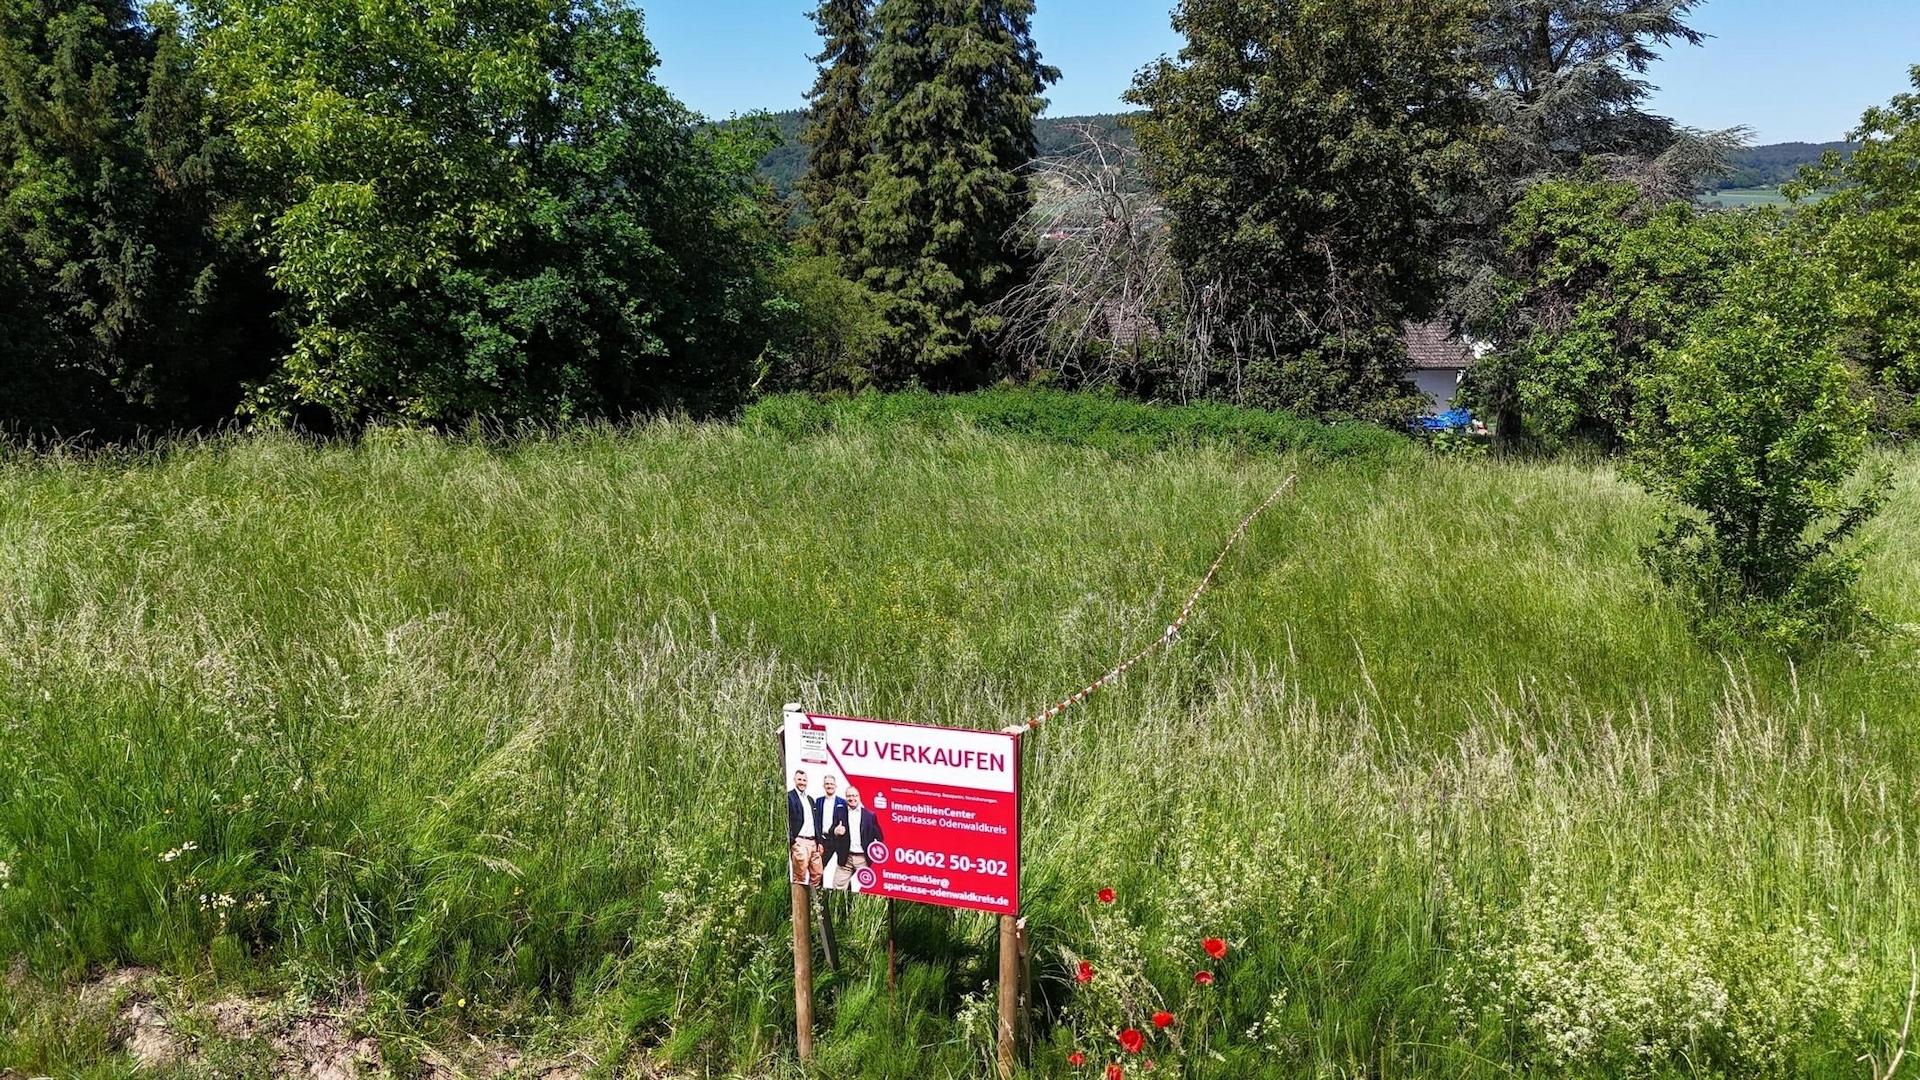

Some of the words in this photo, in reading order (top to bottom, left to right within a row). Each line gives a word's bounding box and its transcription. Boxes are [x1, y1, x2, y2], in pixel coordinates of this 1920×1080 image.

[841, 738, 869, 758] ZU
[874, 741, 1005, 772] VERKAUFEN
[891, 801, 976, 820] ImmobilienCenter
[892, 812, 937, 826] Sparkasse
[939, 817, 1007, 834] Odenwaldkreis
[894, 848, 945, 869] 06062
[950, 854, 1008, 877] 50-302
[882, 869, 950, 889] immo-makler@
[883, 882, 1009, 907] sparkasse-odenwaldkreis.de
